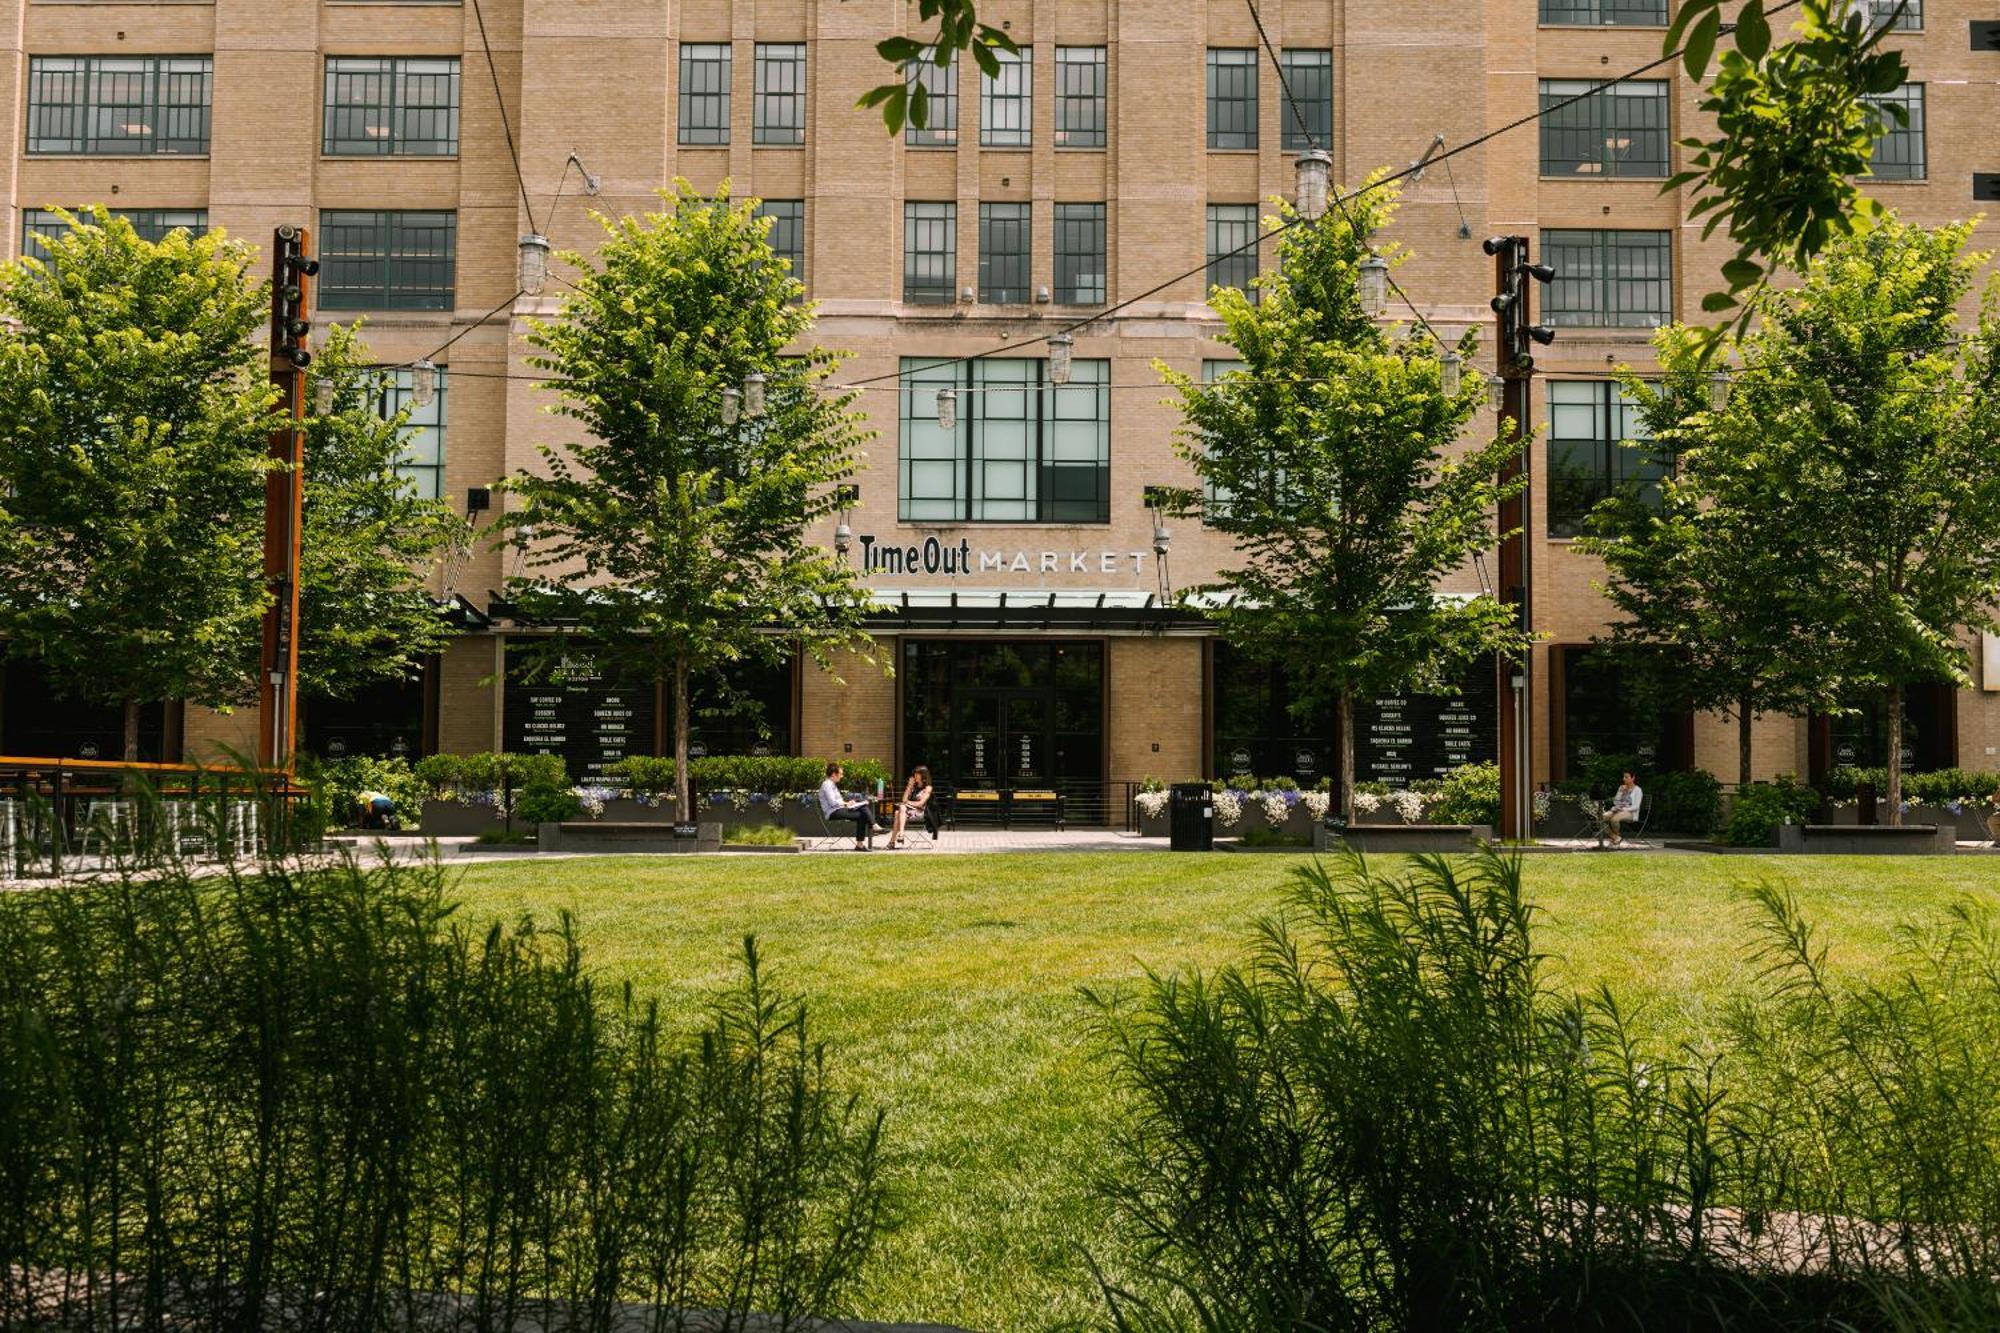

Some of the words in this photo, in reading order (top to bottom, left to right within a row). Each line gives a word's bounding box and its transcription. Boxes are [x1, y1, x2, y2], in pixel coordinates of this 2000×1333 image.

[859, 535, 919, 577] Time
[923, 536, 971, 575] Out
[979, 551, 1148, 574] MARKET
